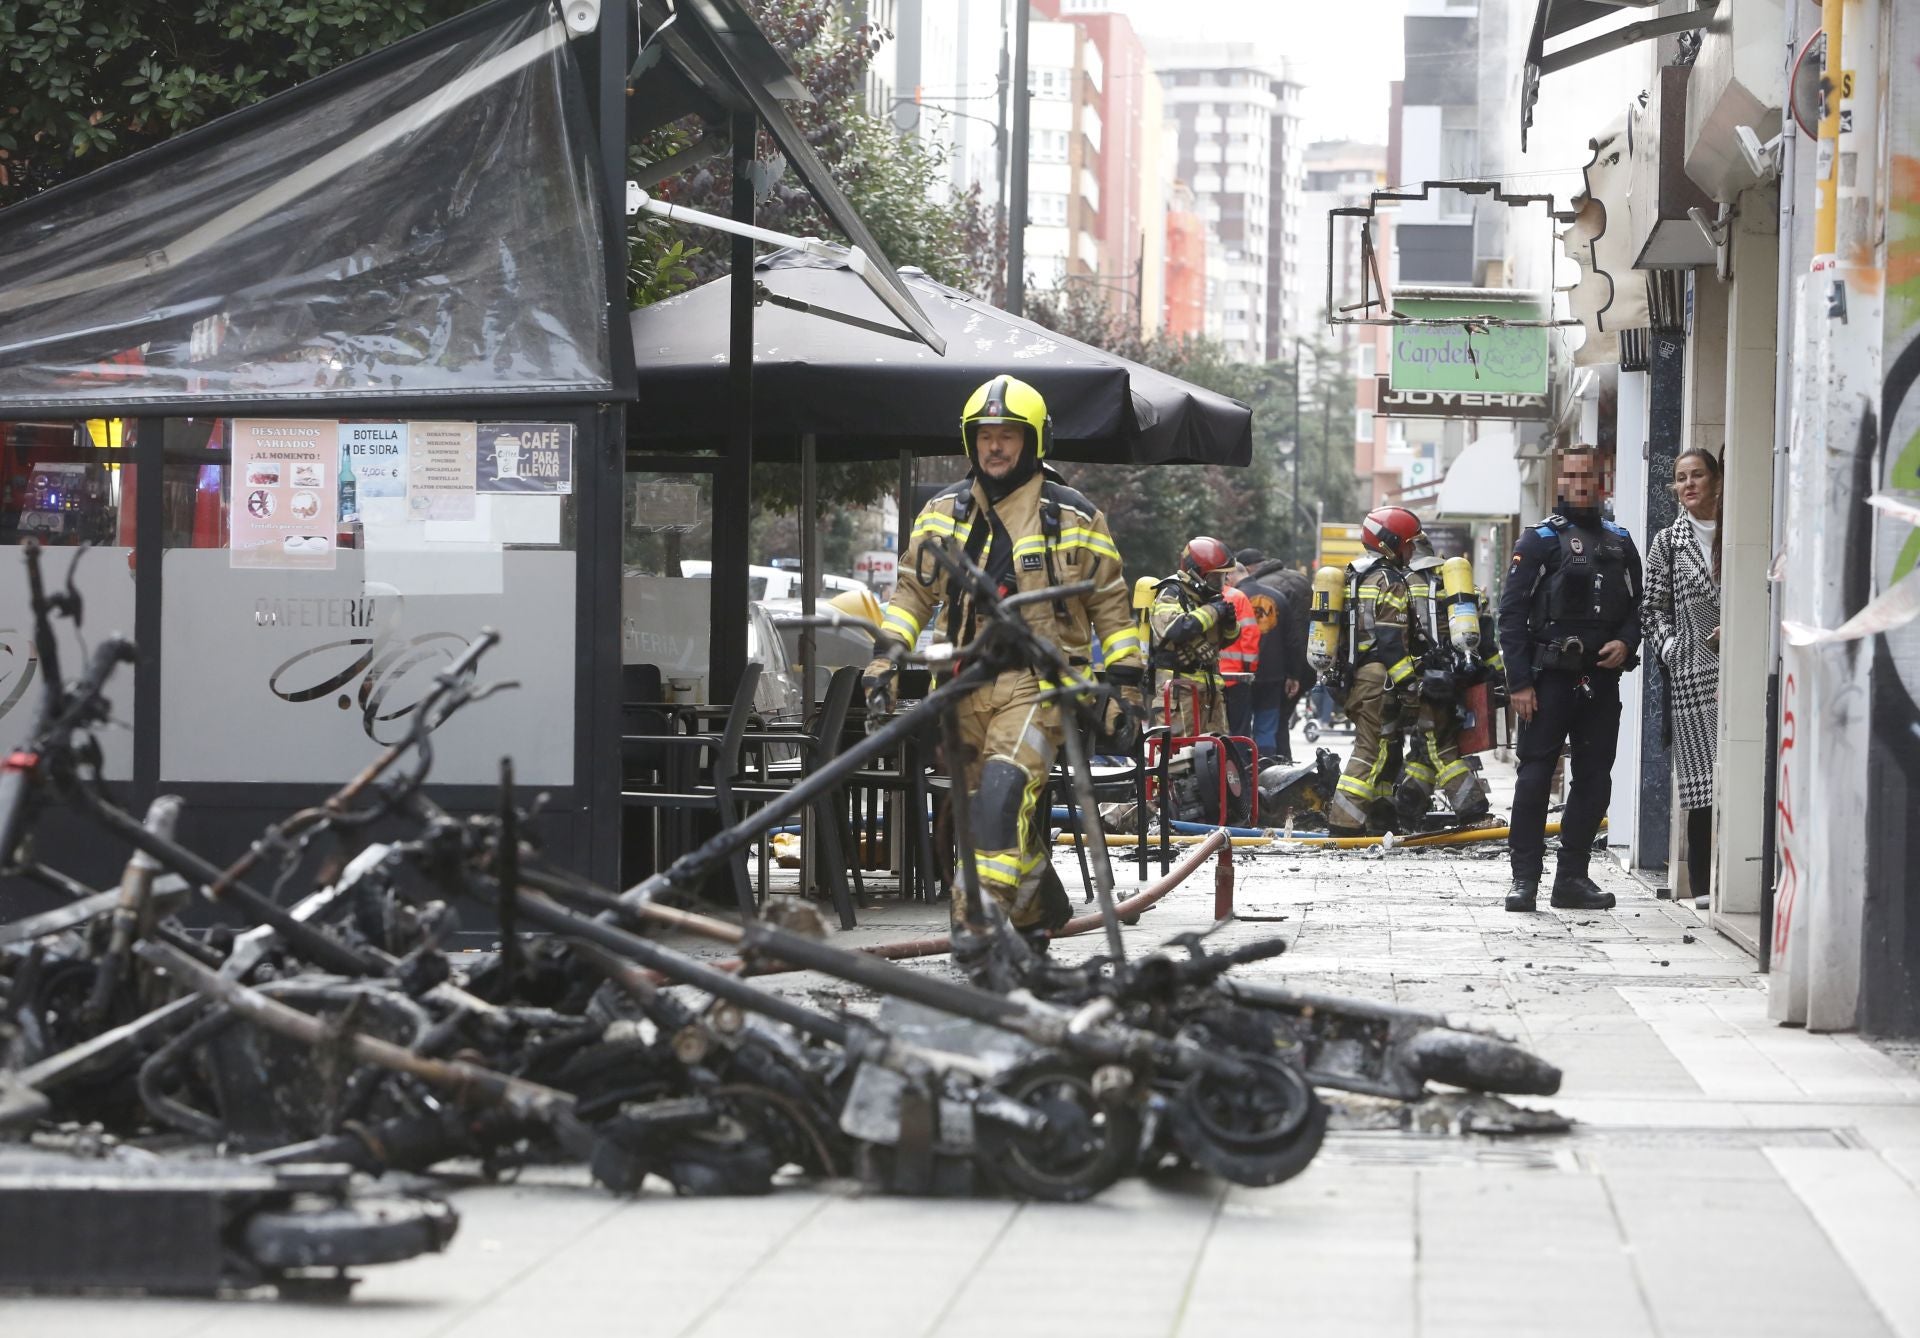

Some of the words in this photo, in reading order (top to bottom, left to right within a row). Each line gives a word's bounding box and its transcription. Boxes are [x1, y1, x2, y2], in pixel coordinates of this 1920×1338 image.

[251, 427, 321, 436] DESAYUNOS
[353, 430, 398, 440] BOTELLA
[521, 428, 560, 449] CAFÉ
[256, 440, 316, 448] VARIADOS
[353, 445, 364, 455] DE
[369, 445, 399, 455] SIDRA
[532, 451, 560, 465] PARA
[520, 464, 559, 477] LLEVAR
